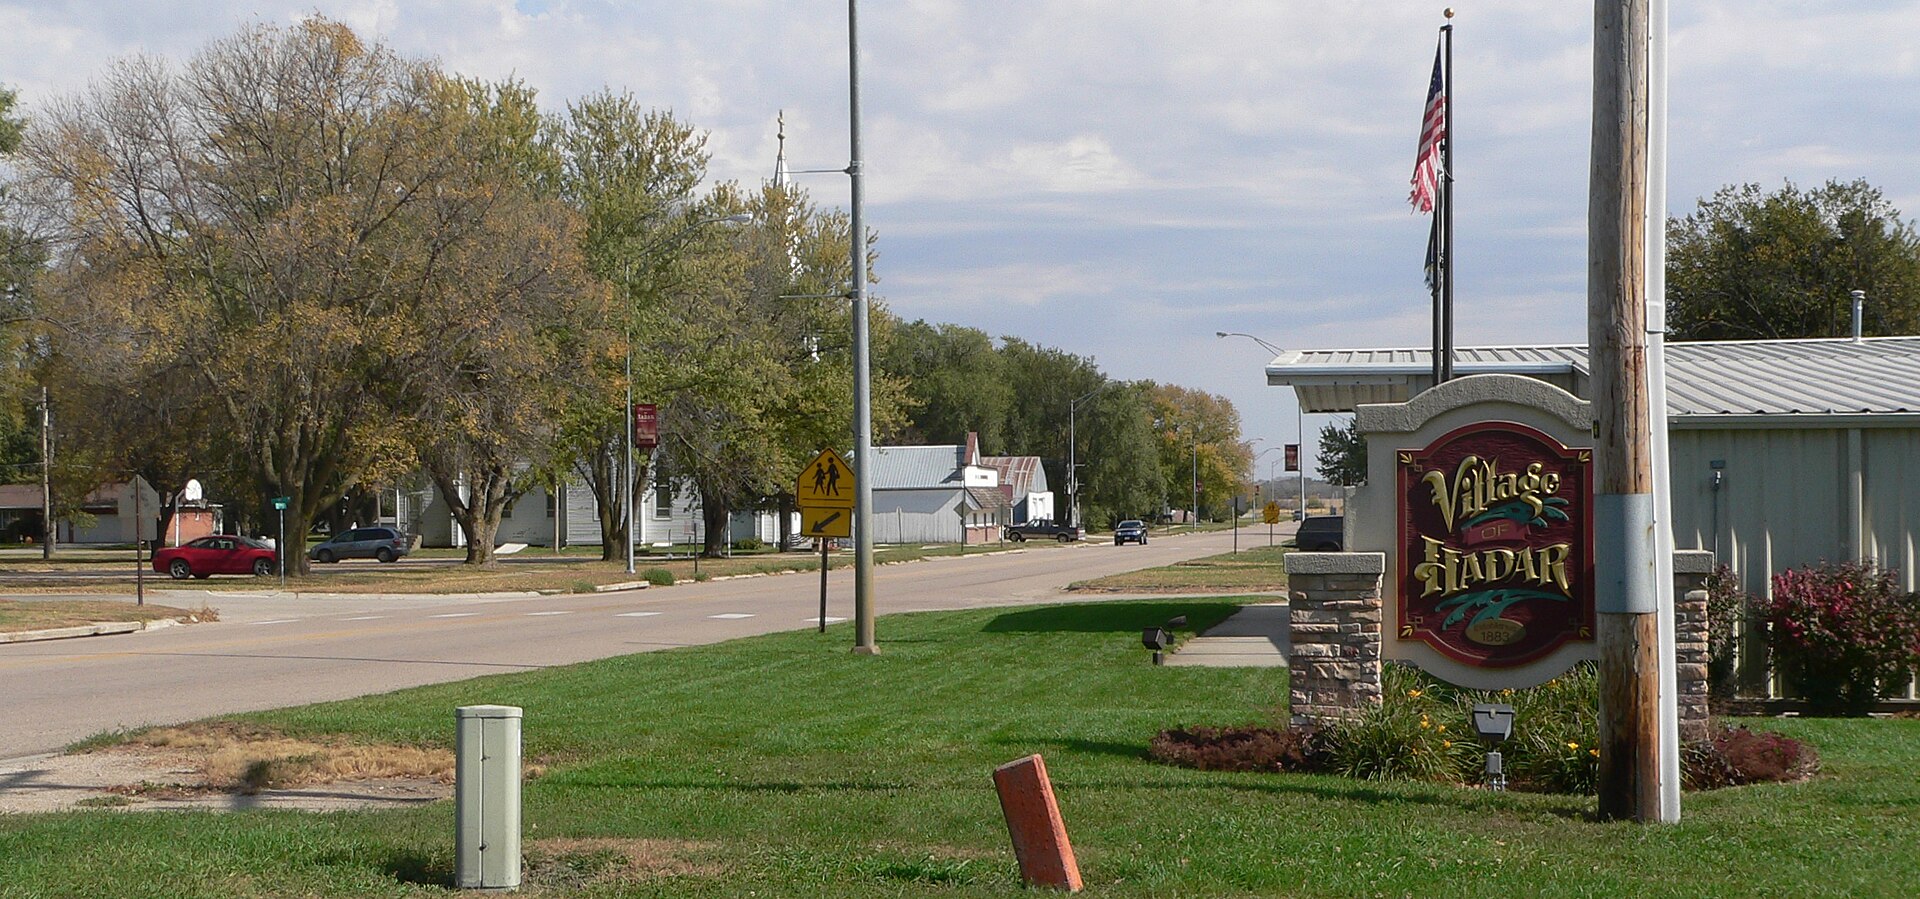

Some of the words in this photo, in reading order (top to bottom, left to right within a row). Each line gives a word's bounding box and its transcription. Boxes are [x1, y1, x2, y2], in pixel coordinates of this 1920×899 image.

[1421, 455, 1561, 533] Village
[1481, 524, 1510, 539] OF
[1414, 534, 1573, 599] HADAR
[1480, 631, 1510, 642] 1883
